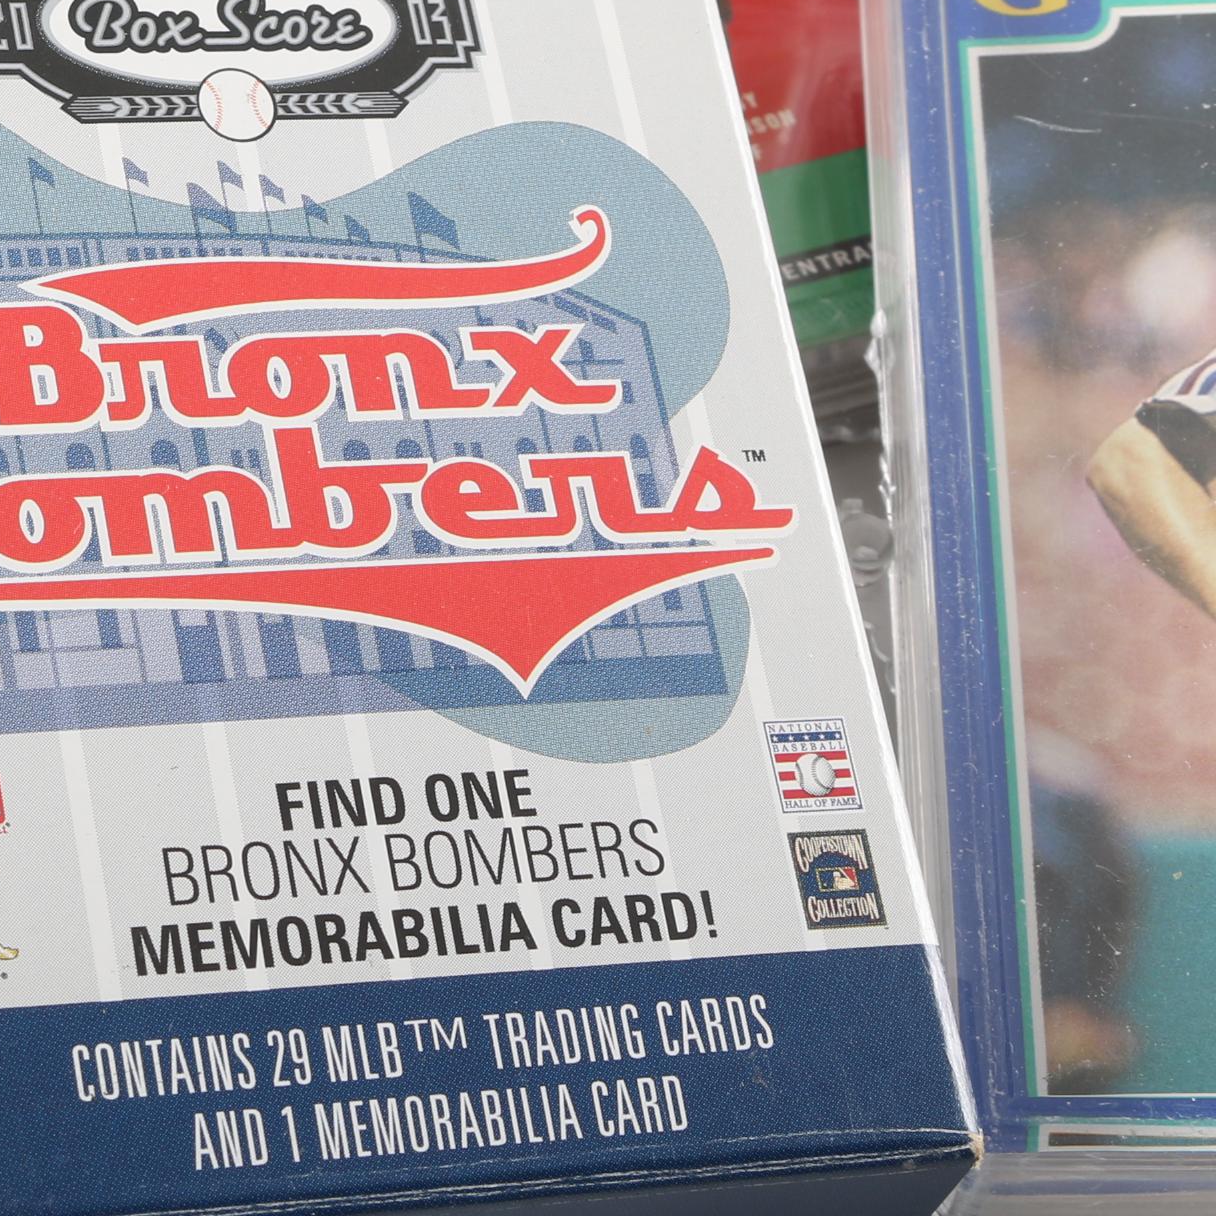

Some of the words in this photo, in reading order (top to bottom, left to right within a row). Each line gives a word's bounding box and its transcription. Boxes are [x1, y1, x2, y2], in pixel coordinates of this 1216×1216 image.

[781, 243, 873, 281] ENTRA
[768, 720, 842, 733] NATIONAL
[772, 741, 846, 753] BASEBALL
[275, 776, 406, 831] FIND
[425, 769, 537, 823] ONE
[784, 800, 812, 809] HALL
[814, 799, 829, 808] OF
[830, 797, 857, 808] FAME
[162, 836, 371, 906] BRONX
[385, 819, 666, 892] BOMBERS
[794, 834, 869, 873] COOPERSTOWN
[807, 892, 880, 923] COLLECTION
[130, 902, 537, 976] MEMORABILIA
[551, 890, 718, 949] CARD!
[72, 1032, 256, 1102] CONTAINS
[267, 1028, 312, 1087] 29
[483, 1004, 646, 1069] TRADING
[655, 994, 774, 1056] CARDS
[194, 1109, 268, 1171] AND
[281, 1106, 300, 1163] 1
[314, 1084, 583, 1161] MEMORABILIA
[591, 1075, 688, 1138] CARD
